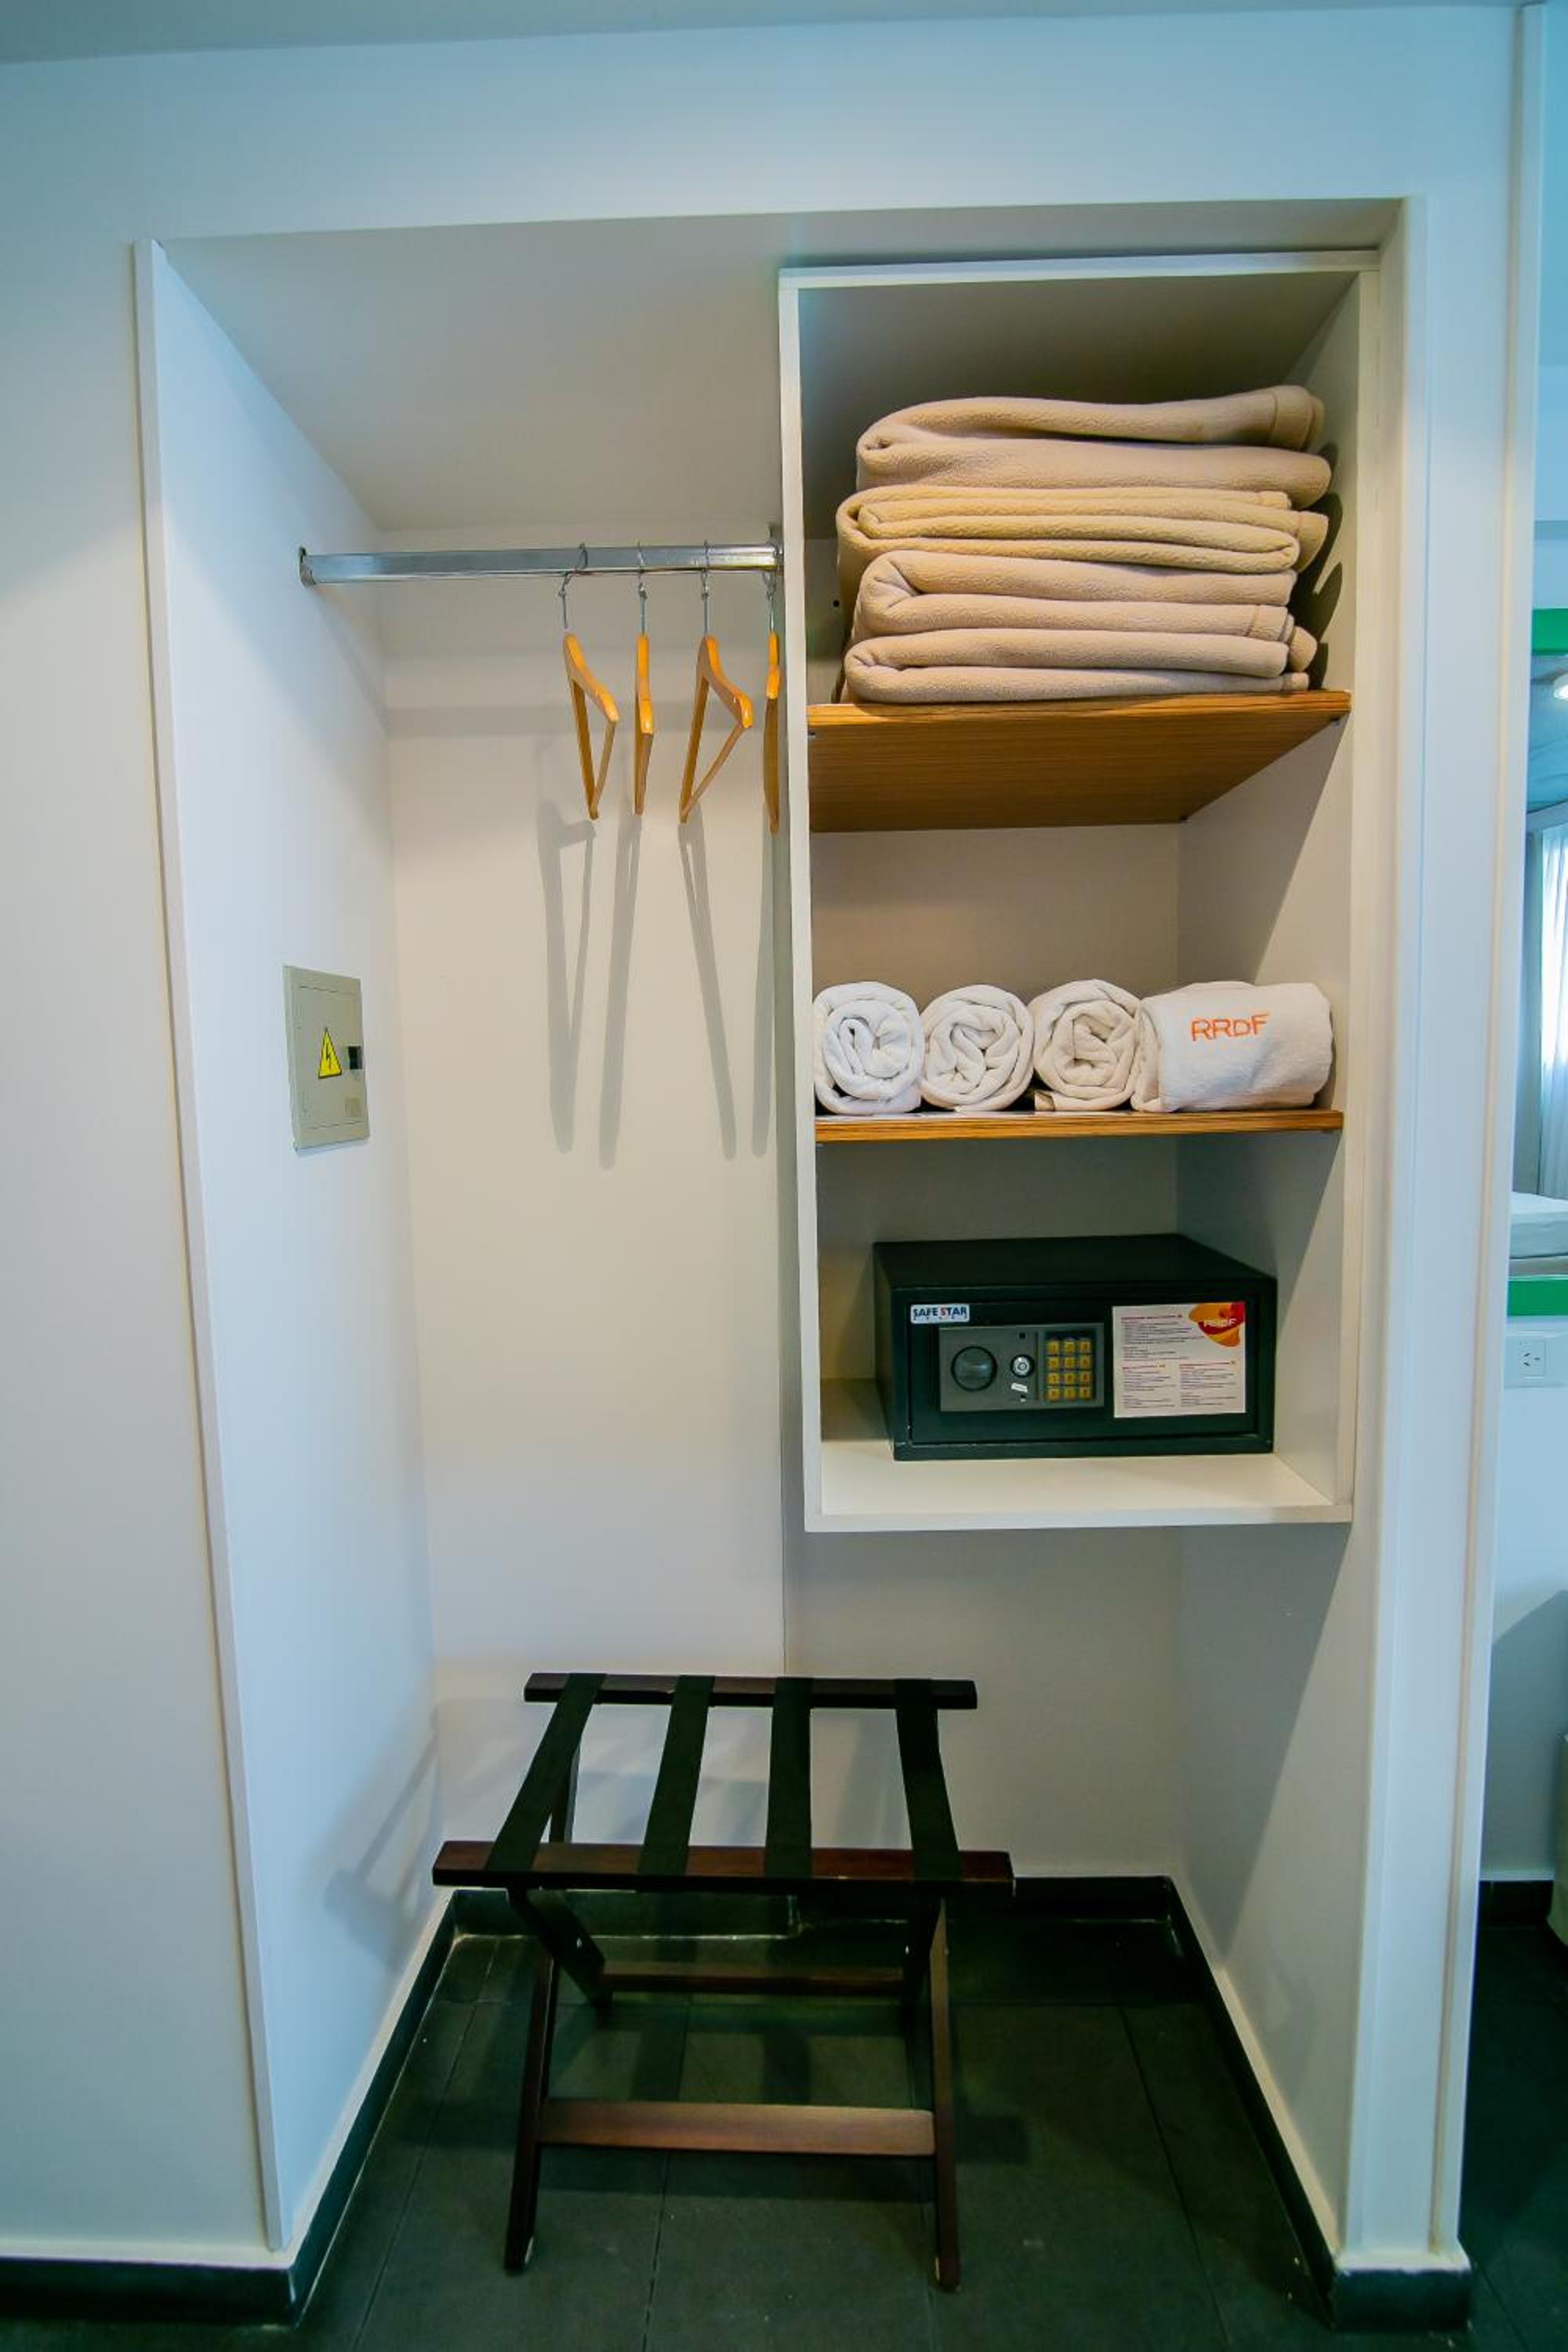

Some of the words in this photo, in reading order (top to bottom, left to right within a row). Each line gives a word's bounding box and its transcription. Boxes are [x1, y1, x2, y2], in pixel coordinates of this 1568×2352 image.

[1192, 1013, 1269, 1041] RRDF
[913, 1307, 938, 1316] SAFE
[941, 1306, 967, 1316] STAR
